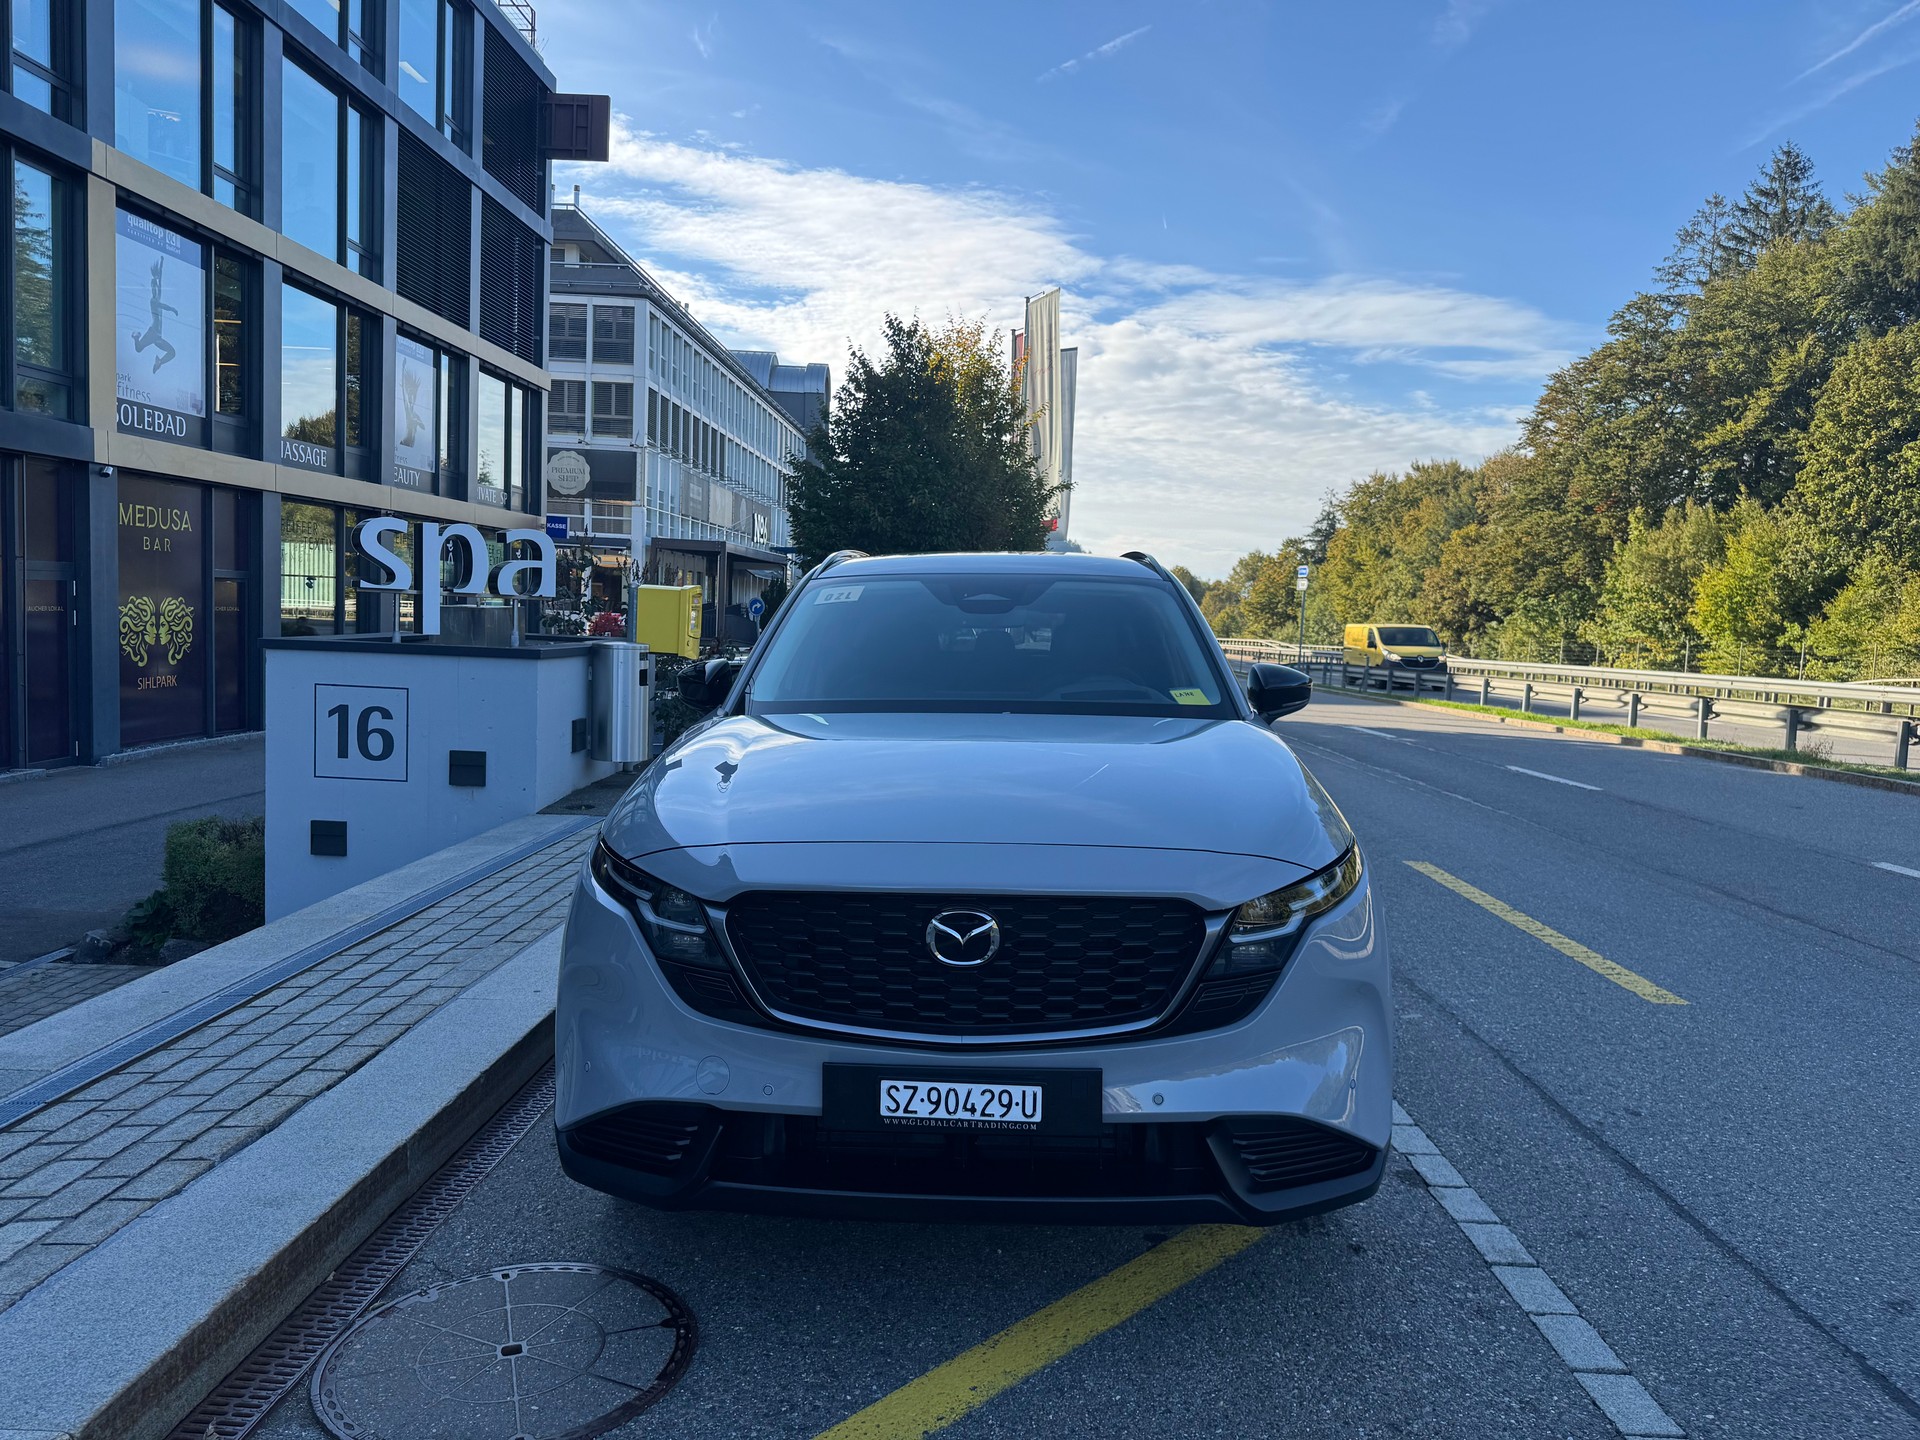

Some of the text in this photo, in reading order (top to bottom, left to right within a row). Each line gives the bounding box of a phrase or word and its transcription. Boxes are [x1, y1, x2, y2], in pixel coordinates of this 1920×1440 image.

[117, 381, 151, 402] fitness
[551, 466, 585, 475] PREMIUM
[119, 502, 192, 532] MEDUSA
[143, 536, 172, 552] BAR
[352, 516, 557, 635] spa
[137, 674, 178, 690] SIHLPARK
[327, 704, 395, 762] 16
